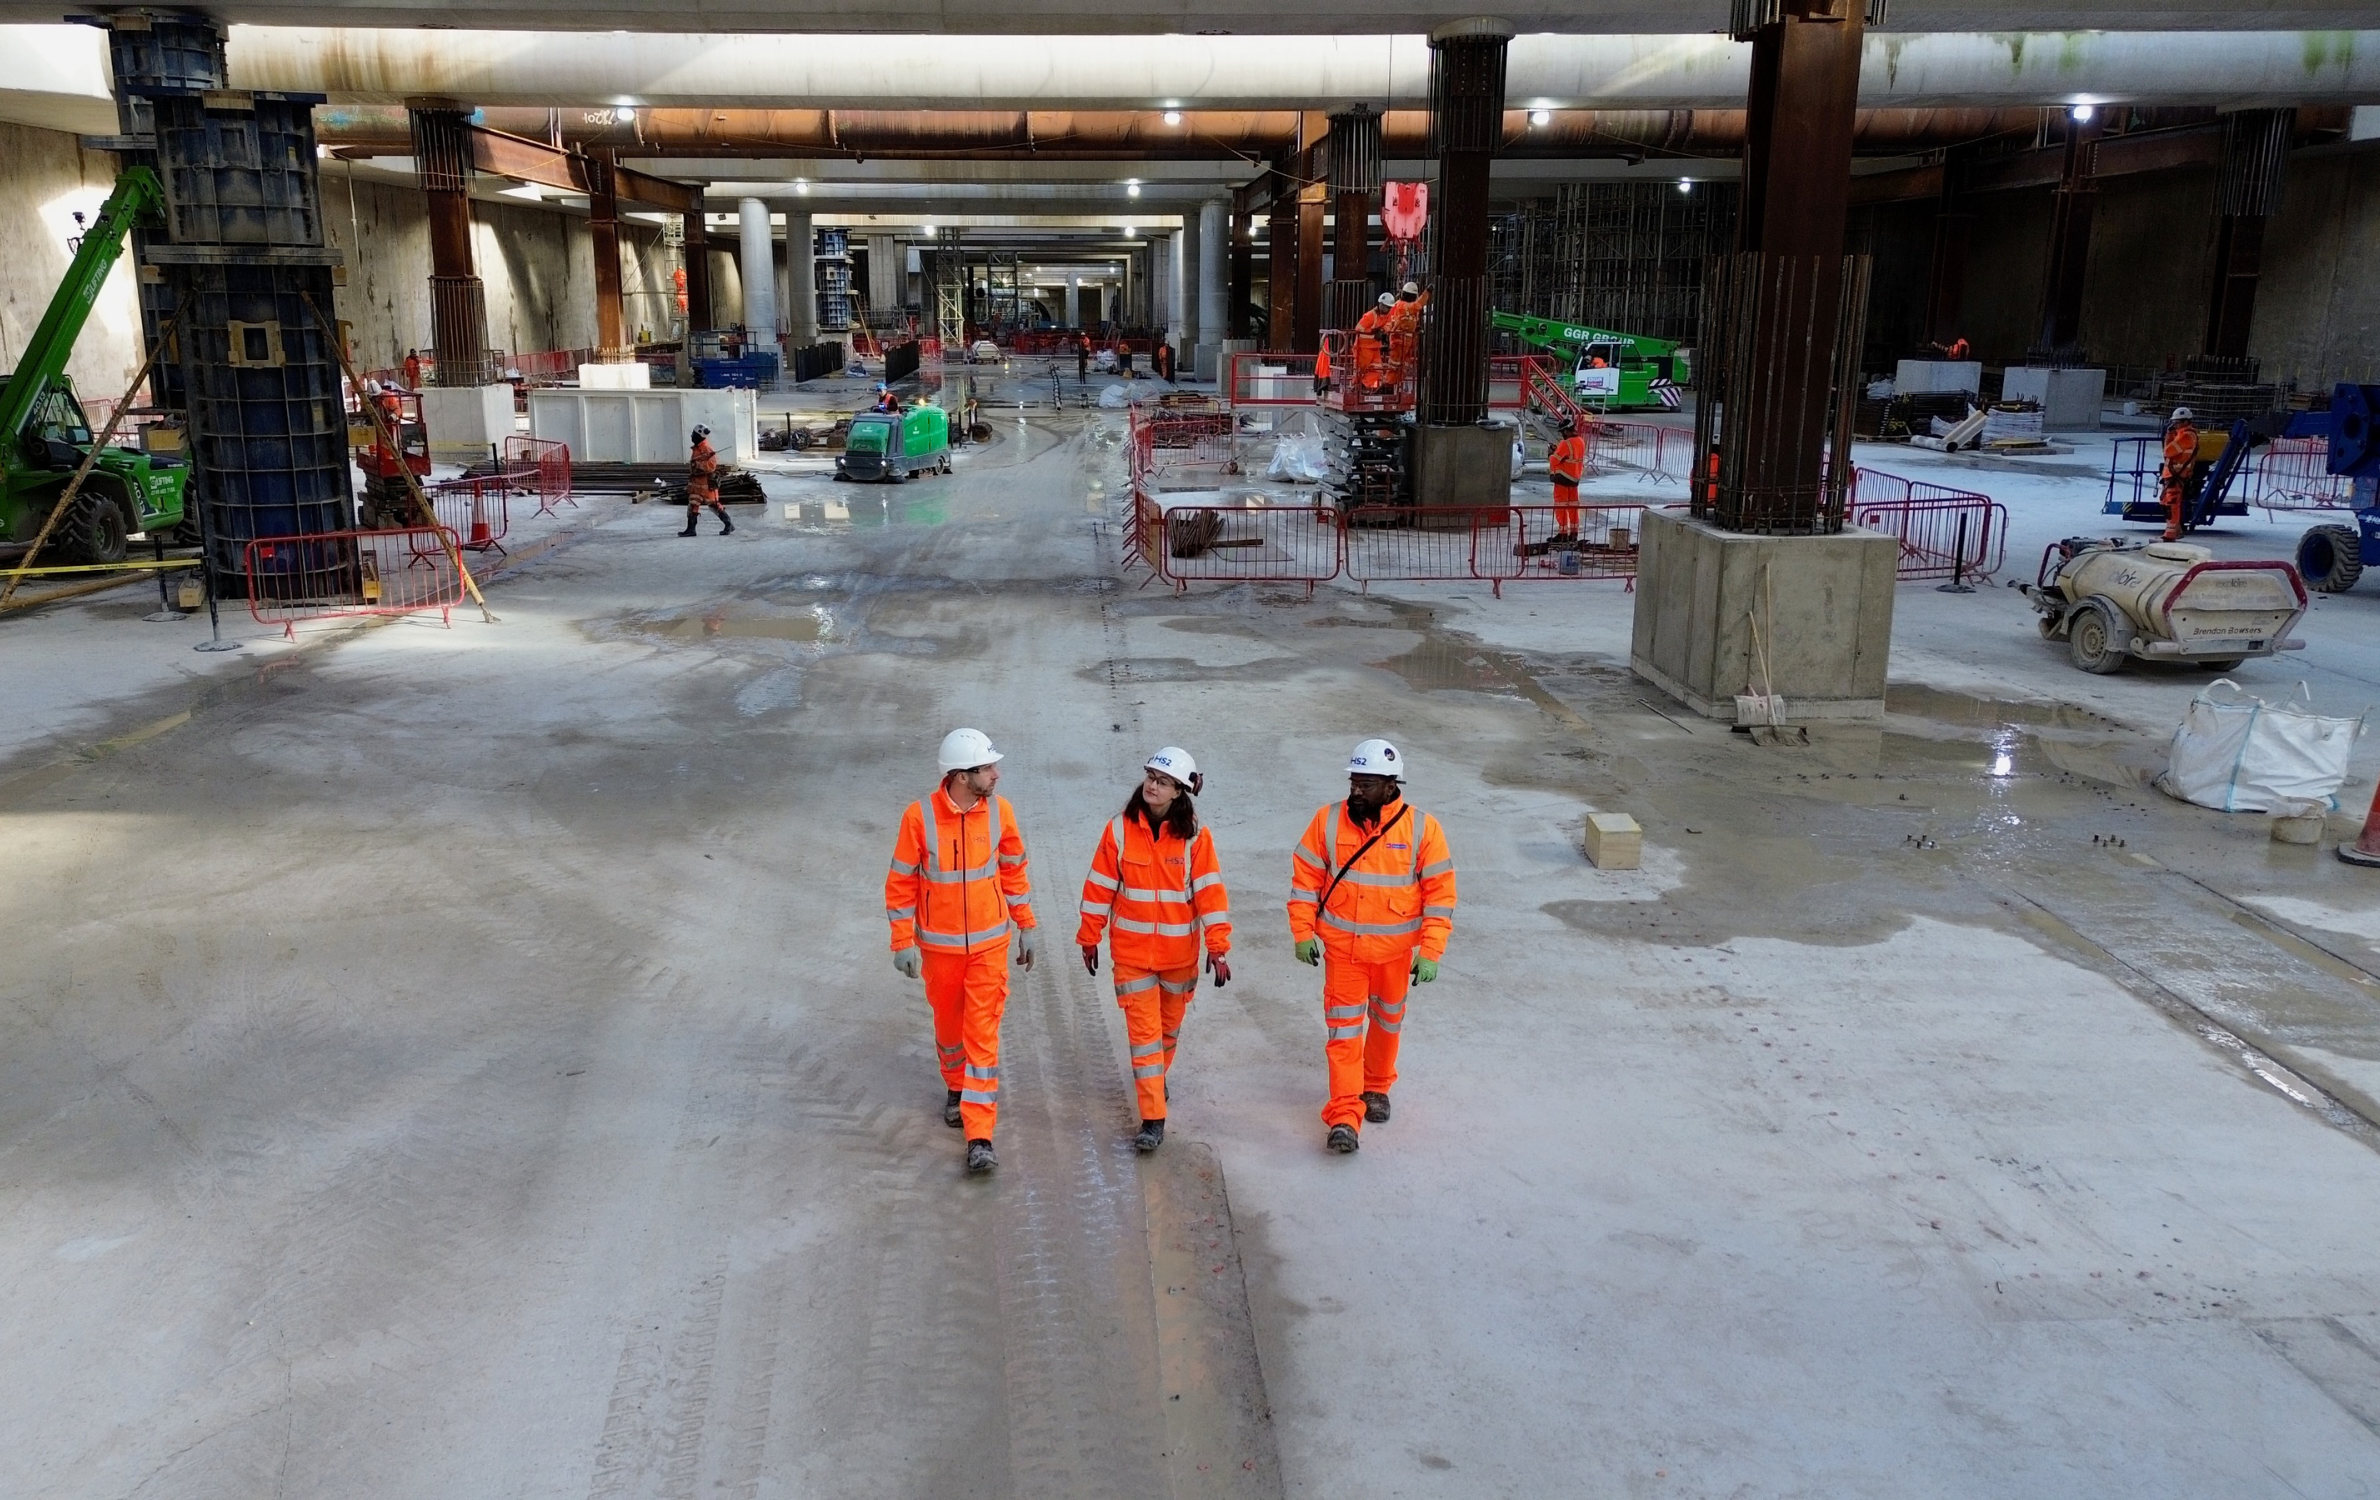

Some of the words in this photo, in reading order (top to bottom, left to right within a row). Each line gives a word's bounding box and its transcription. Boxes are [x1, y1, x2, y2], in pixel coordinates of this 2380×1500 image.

[89, 259, 107, 292] LIFTING
[1563, 327, 1590, 340] GGR
[2193, 627, 2226, 636] Brendon
[2228, 626, 2262, 635] Bowsers
[1154, 755, 1172, 766] HS2
[1350, 757, 1367, 766] HS2
